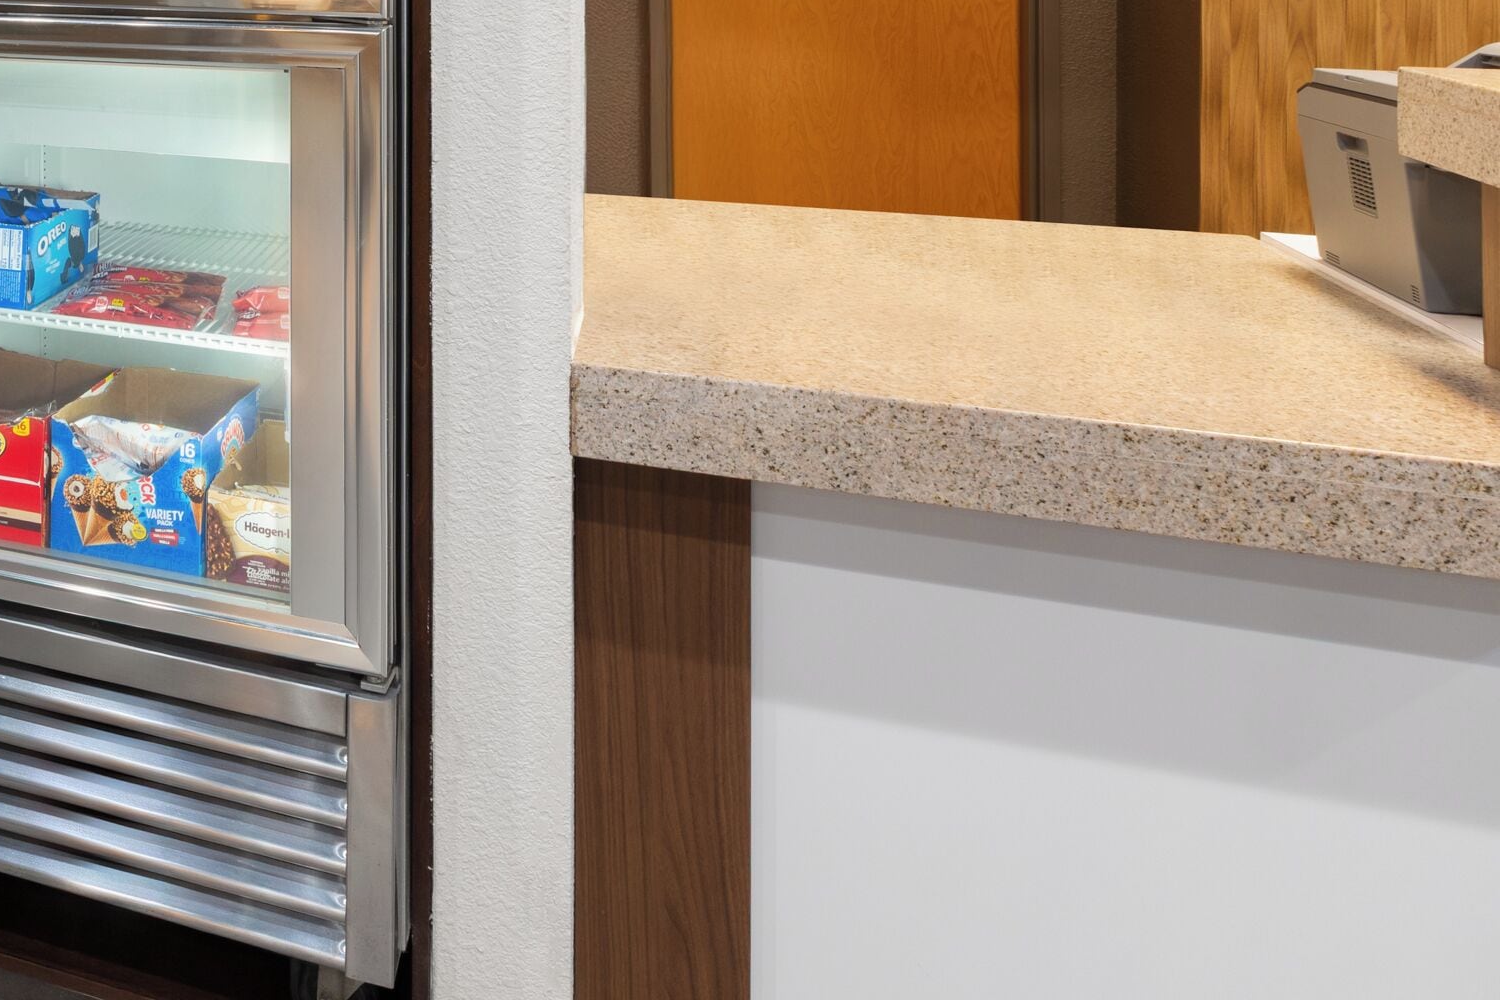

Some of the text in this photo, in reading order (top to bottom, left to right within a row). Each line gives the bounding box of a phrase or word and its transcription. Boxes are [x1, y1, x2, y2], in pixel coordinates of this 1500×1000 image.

[37, 221, 67, 256] OREO
[180, 443, 196, 458] 16
[145, 508, 184, 521] VARIETY
[156, 519, 174, 527] PACK
